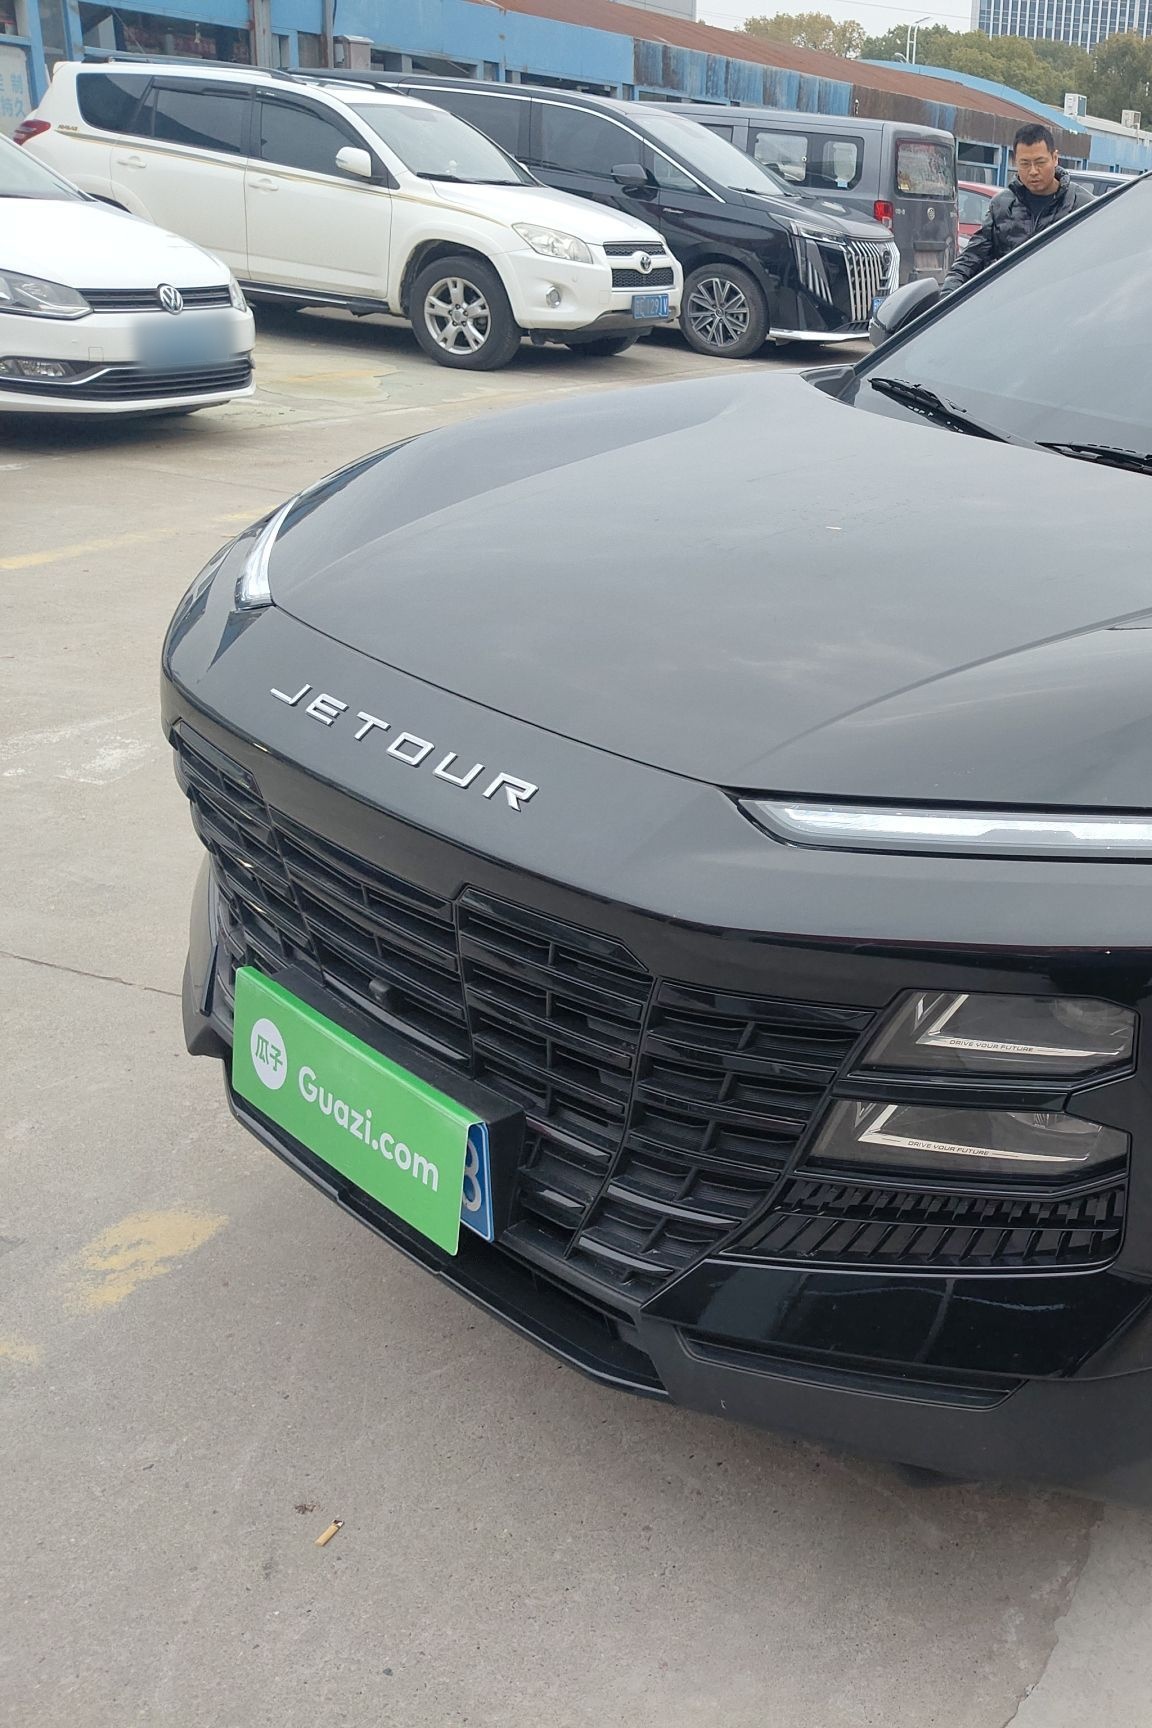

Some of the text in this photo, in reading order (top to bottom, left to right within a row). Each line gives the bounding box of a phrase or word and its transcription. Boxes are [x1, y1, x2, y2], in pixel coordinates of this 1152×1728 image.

[270, 684, 539, 812] JETOUR
[256, 1034, 284, 1072] 瓜子
[949, 1039, 1034, 1053] DRIVE YOUR FUTURE
[298, 1066, 440, 1192] Guazi.com
[907, 1140, 990, 1156] DRIVE YOUR FUTURE
